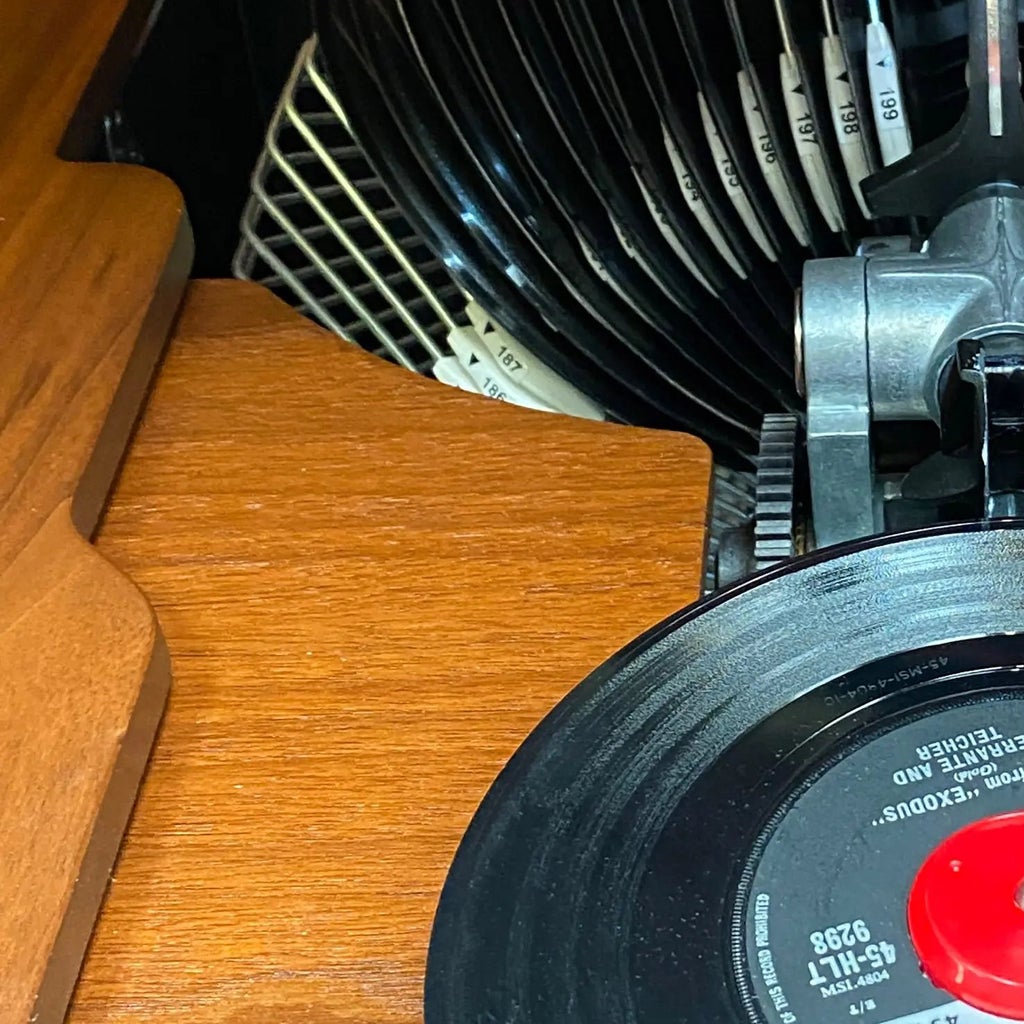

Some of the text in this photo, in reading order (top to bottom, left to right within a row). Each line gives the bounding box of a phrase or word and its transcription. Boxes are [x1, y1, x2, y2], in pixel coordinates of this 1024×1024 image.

[839, 101, 860, 135] 198
[880, 88, 899, 121] 199
[797, 113, 818, 144] 197
[758, 134, 776, 164] 196
[495, 345, 523, 372] 187
[915, 725, 1003, 761] TEICHER
[892, 762, 933, 786] AND
[953, 762, 998, 783] (Gold)
[754, 893, 770, 947] PROHIBITED
[809, 919, 871, 955] 9298
[758, 949, 778, 986] RECORD
[807, 940, 897, 986] 45-HLT
[768, 985, 789, 1011] THIS
